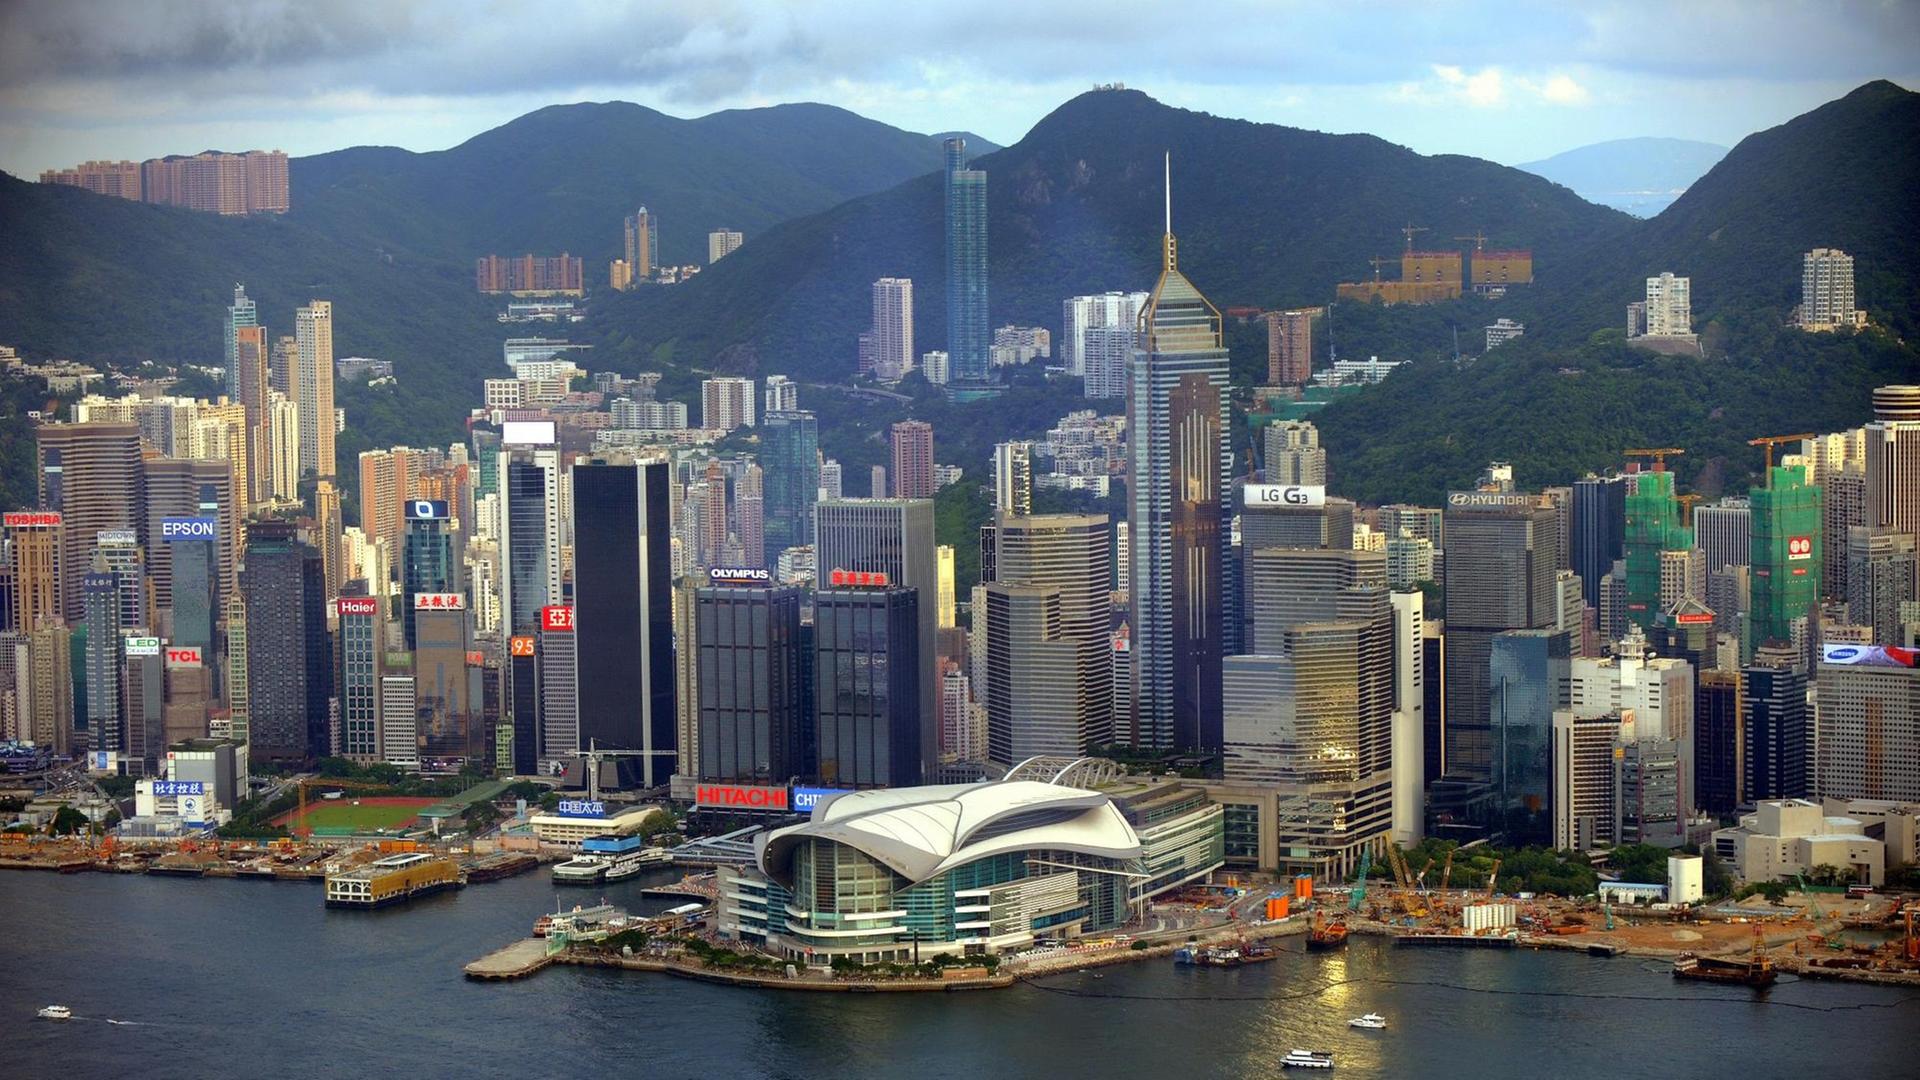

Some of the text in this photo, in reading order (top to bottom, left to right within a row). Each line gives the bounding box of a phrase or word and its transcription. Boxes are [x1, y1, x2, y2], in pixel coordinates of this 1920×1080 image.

[1261, 487, 1308, 504] LG G3
[1471, 495, 1528, 505] HYUNDAI
[5, 514, 60, 525] TOSHIBA
[162, 522, 213, 535] EPSON
[98, 532, 134, 540] MIDTOWN
[711, 568, 769, 578] OLYMPUS
[341, 601, 375, 613] Haier
[126, 639, 158, 648] LED
[168, 651, 200, 662] TCL
[697, 786, 786, 808] HITACHI
[795, 793, 822, 807] CHI
[559, 800, 604, 815] 中国太平
